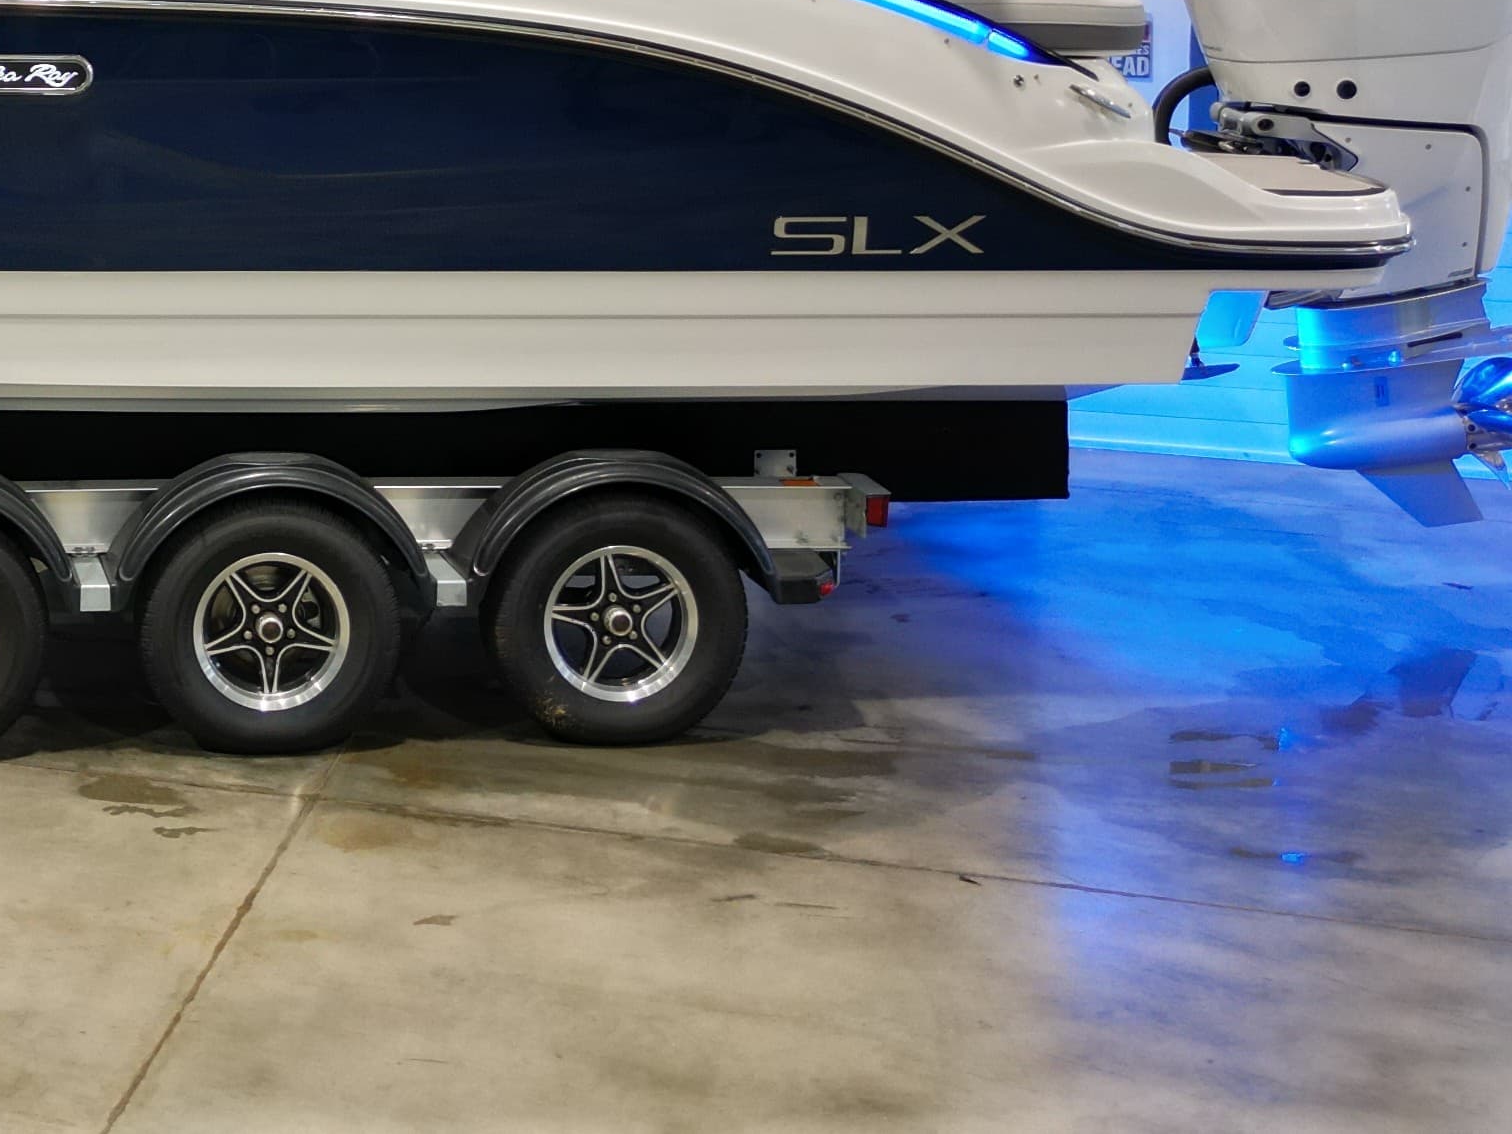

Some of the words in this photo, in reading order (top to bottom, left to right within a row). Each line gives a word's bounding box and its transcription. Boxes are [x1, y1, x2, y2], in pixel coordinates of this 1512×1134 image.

[24, 64, 78, 87] Ray
[1108, 56, 1149, 76] EAD
[770, 215, 986, 255] SLX
